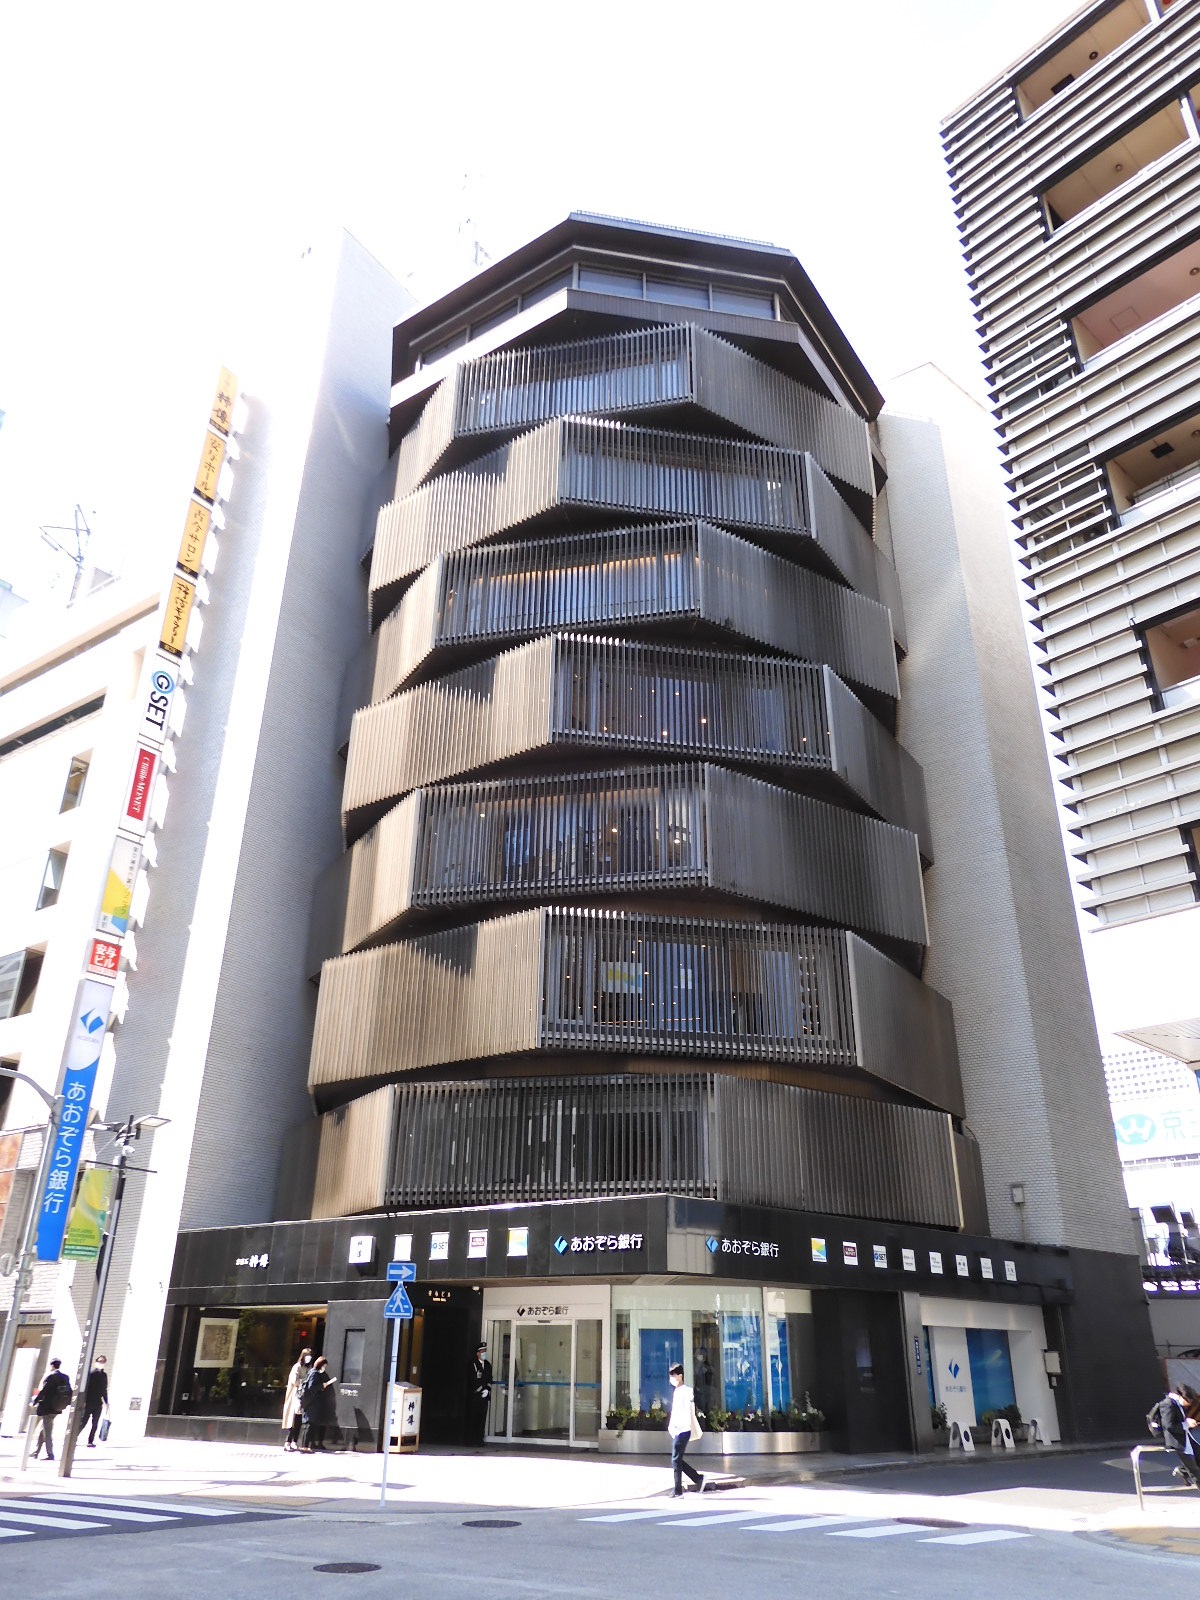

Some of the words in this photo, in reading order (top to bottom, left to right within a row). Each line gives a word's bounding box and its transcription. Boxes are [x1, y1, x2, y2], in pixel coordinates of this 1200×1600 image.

[96, 943, 117, 958] 安与
[94, 955, 115, 969] ビル
[43, 1081, 86, 1214] あおぞら銀行
[571, 1234, 643, 1251] あおぞら銀行
[721, 1238, 779, 1258] あおぞら銀行
[527, 1306, 569, 1316] あおぞら銀行
